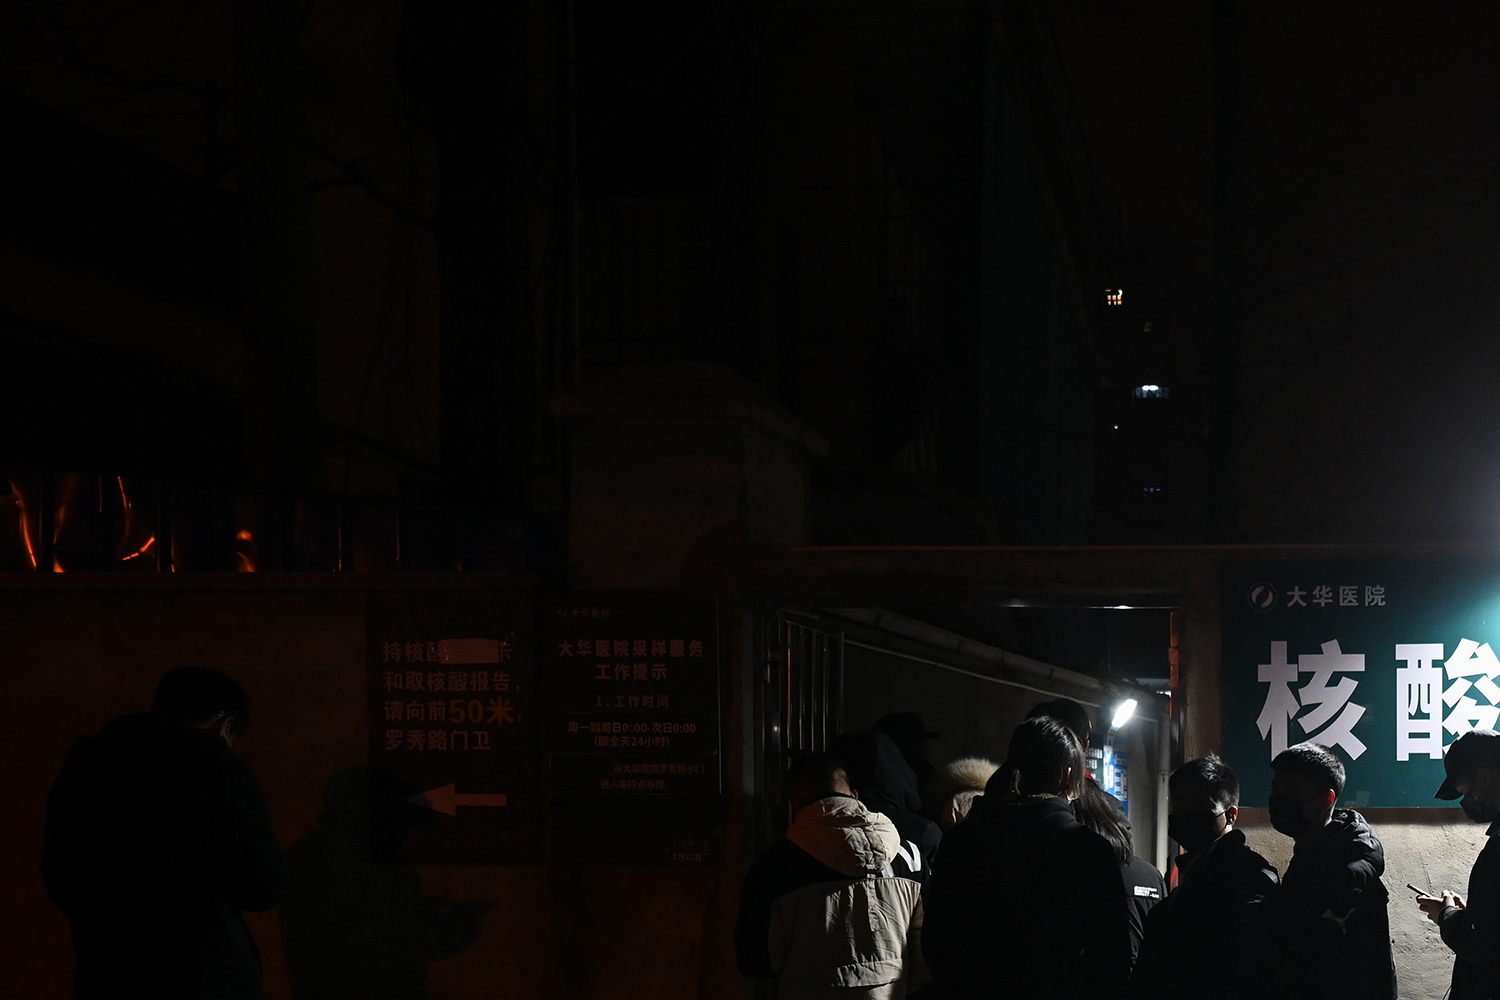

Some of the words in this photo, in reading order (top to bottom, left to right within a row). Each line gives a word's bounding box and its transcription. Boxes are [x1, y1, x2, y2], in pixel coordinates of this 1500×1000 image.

[1286, 585, 1387, 608] 大华医院
[382, 640, 513, 663] 持核酸卡
[558, 639, 704, 658] 大华医院采样服务
[383, 670, 520, 693] 和取核酸报告，
[595, 662, 667, 681] 工作提示
[596, 694, 669, 708] 1、工作时间
[386, 729, 492, 751] 罗秀路门卫
